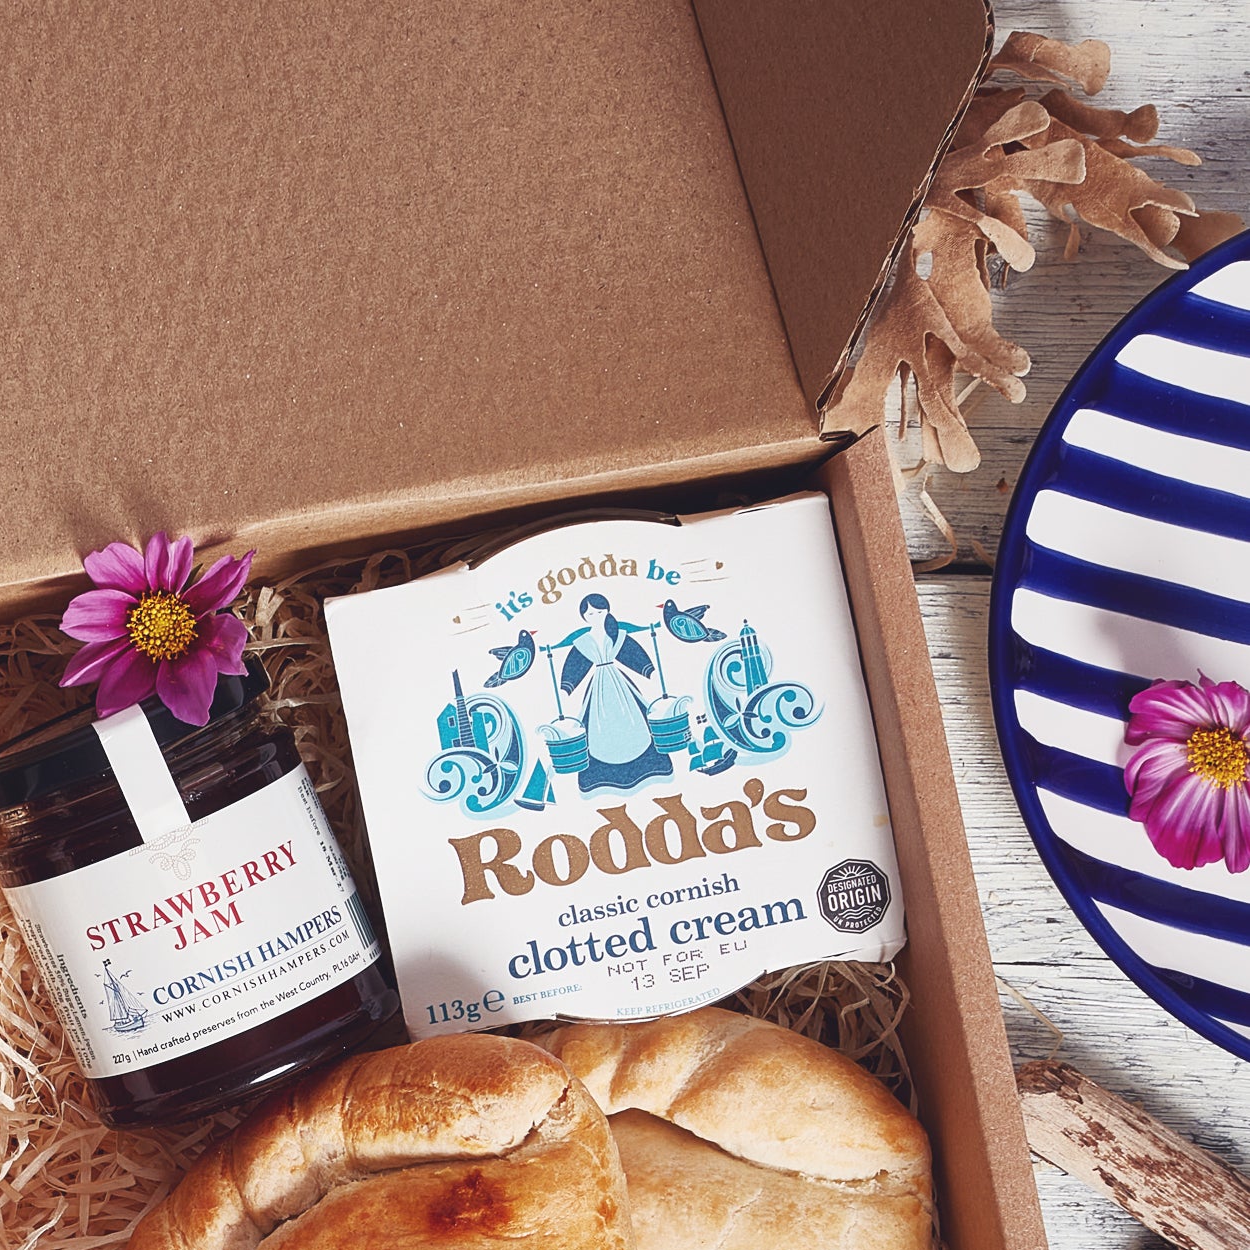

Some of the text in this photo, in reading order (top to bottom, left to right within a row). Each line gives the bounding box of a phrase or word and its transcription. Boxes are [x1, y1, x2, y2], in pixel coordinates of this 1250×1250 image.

[494, 589, 533, 623] it's
[646, 558, 682, 586] be
[306, 806, 320, 836] Before
[447, 777, 817, 907] Rodda's
[85, 840, 299, 953] STRAWBERRY
[558, 873, 741, 928] classic cornish
[827, 874, 878, 894] DESIGNATED
[827, 883, 882, 912] ORIGIN
[173, 899, 245, 952] JAM
[507, 896, 808, 980] clotted cream
[833, 906, 882, 928] UK PROTECTED
[45, 962, 56, 985] with
[152, 904, 343, 1007] CORNISH HAMPERS
[161, 928, 351, 1024] WWW.CORNISHHAMPERS.COM
[607, 939, 748, 977] NOT FOR EU
[632, 962, 711, 992] 13 SEP
[56, 953, 88, 1019] Ingredients
[512, 983, 583, 1005] BEST BEFORE:
[616, 986, 721, 1017] KEEP REFRIGERATED
[112, 1051, 132, 1065] 227g
[137, 1042, 160, 1058] Hand
[160, 1031, 191, 1052] crafted
[192, 1012, 236, 1041] preserves
[236, 1003, 259, 1023] from
[260, 996, 275, 1011] the
[275, 985, 299, 1004] West
[298, 972, 332, 995] Country,
[332, 956, 349, 975] PL16
[426, 998, 482, 1025] 113g
